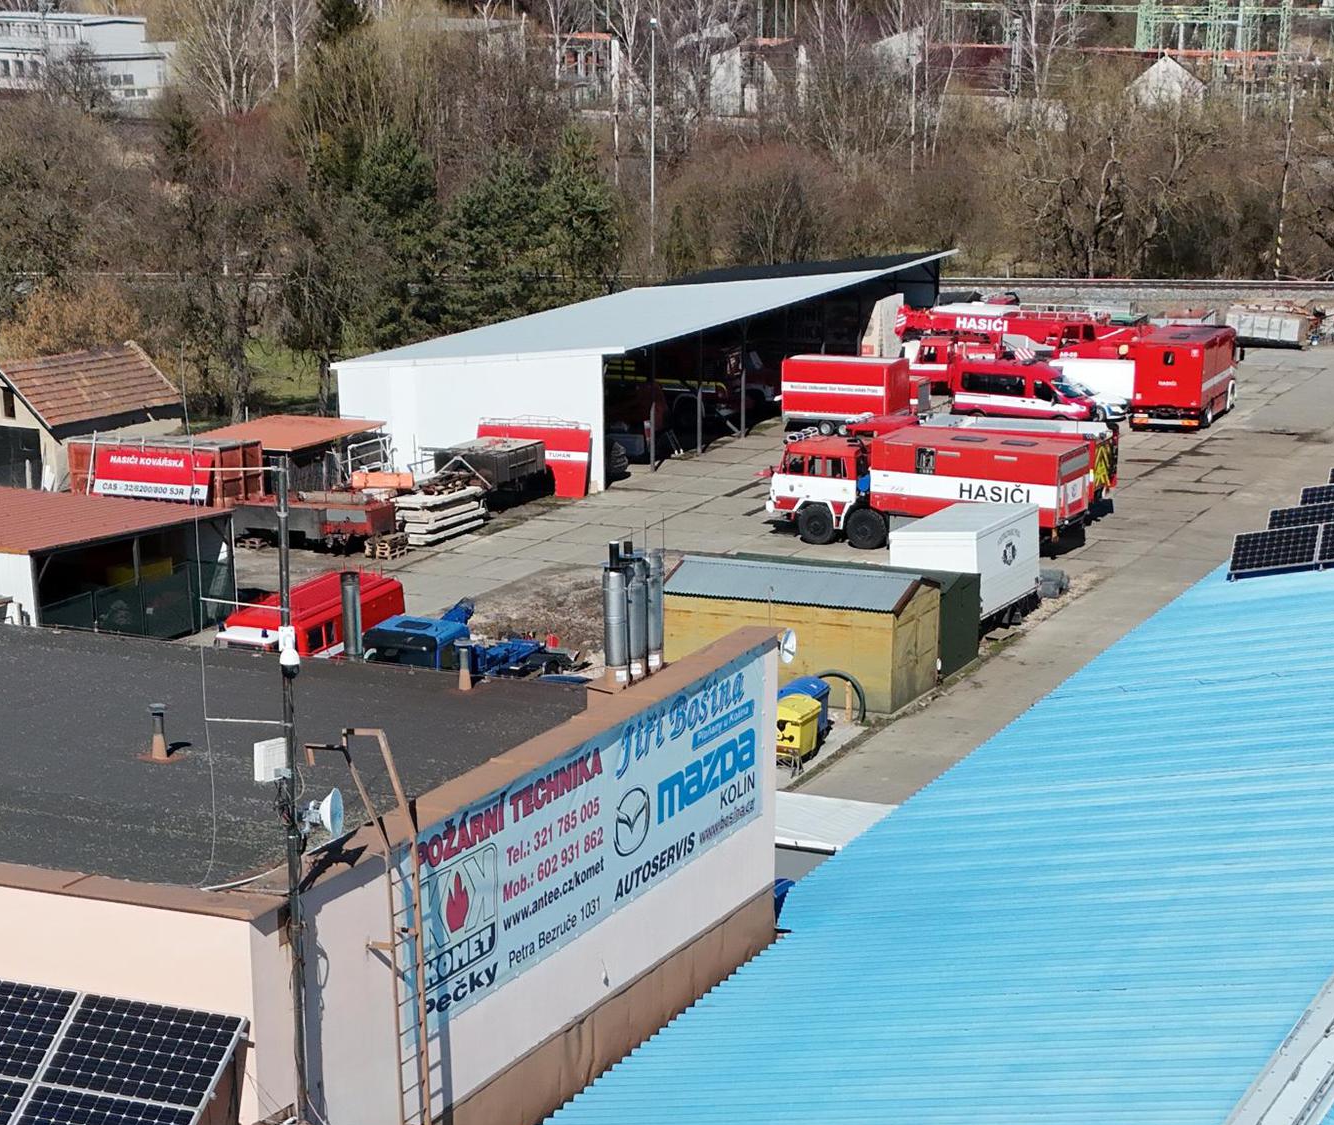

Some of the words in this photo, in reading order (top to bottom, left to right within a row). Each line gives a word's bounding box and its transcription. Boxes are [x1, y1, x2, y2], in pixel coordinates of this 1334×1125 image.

[959, 483, 1030, 504] HASIČI
[418, 791, 507, 868] POŽÁRNÍ
[509, 747, 603, 823] TECHNIKA
[720, 770, 756, 810] KOLÍN
[502, 871, 535, 904] Mob.:
[537, 854, 558, 882] 602
[560, 840, 580, 868] 931
[583, 826, 604, 854] 862
[506, 840, 531, 867] Tel.:
[533, 824, 554, 852] 321
[557, 811, 578, 838] 785
[580, 797, 600, 823] 005
[614, 832, 696, 902] AUTOSERVIS
[502, 856, 605, 935] www.antee.cz/komet
[424, 931, 493, 986] KOMET
[509, 941, 536, 969] Petra
[538, 914, 578, 949] Bezruče
[579, 896, 602, 923] 1031
